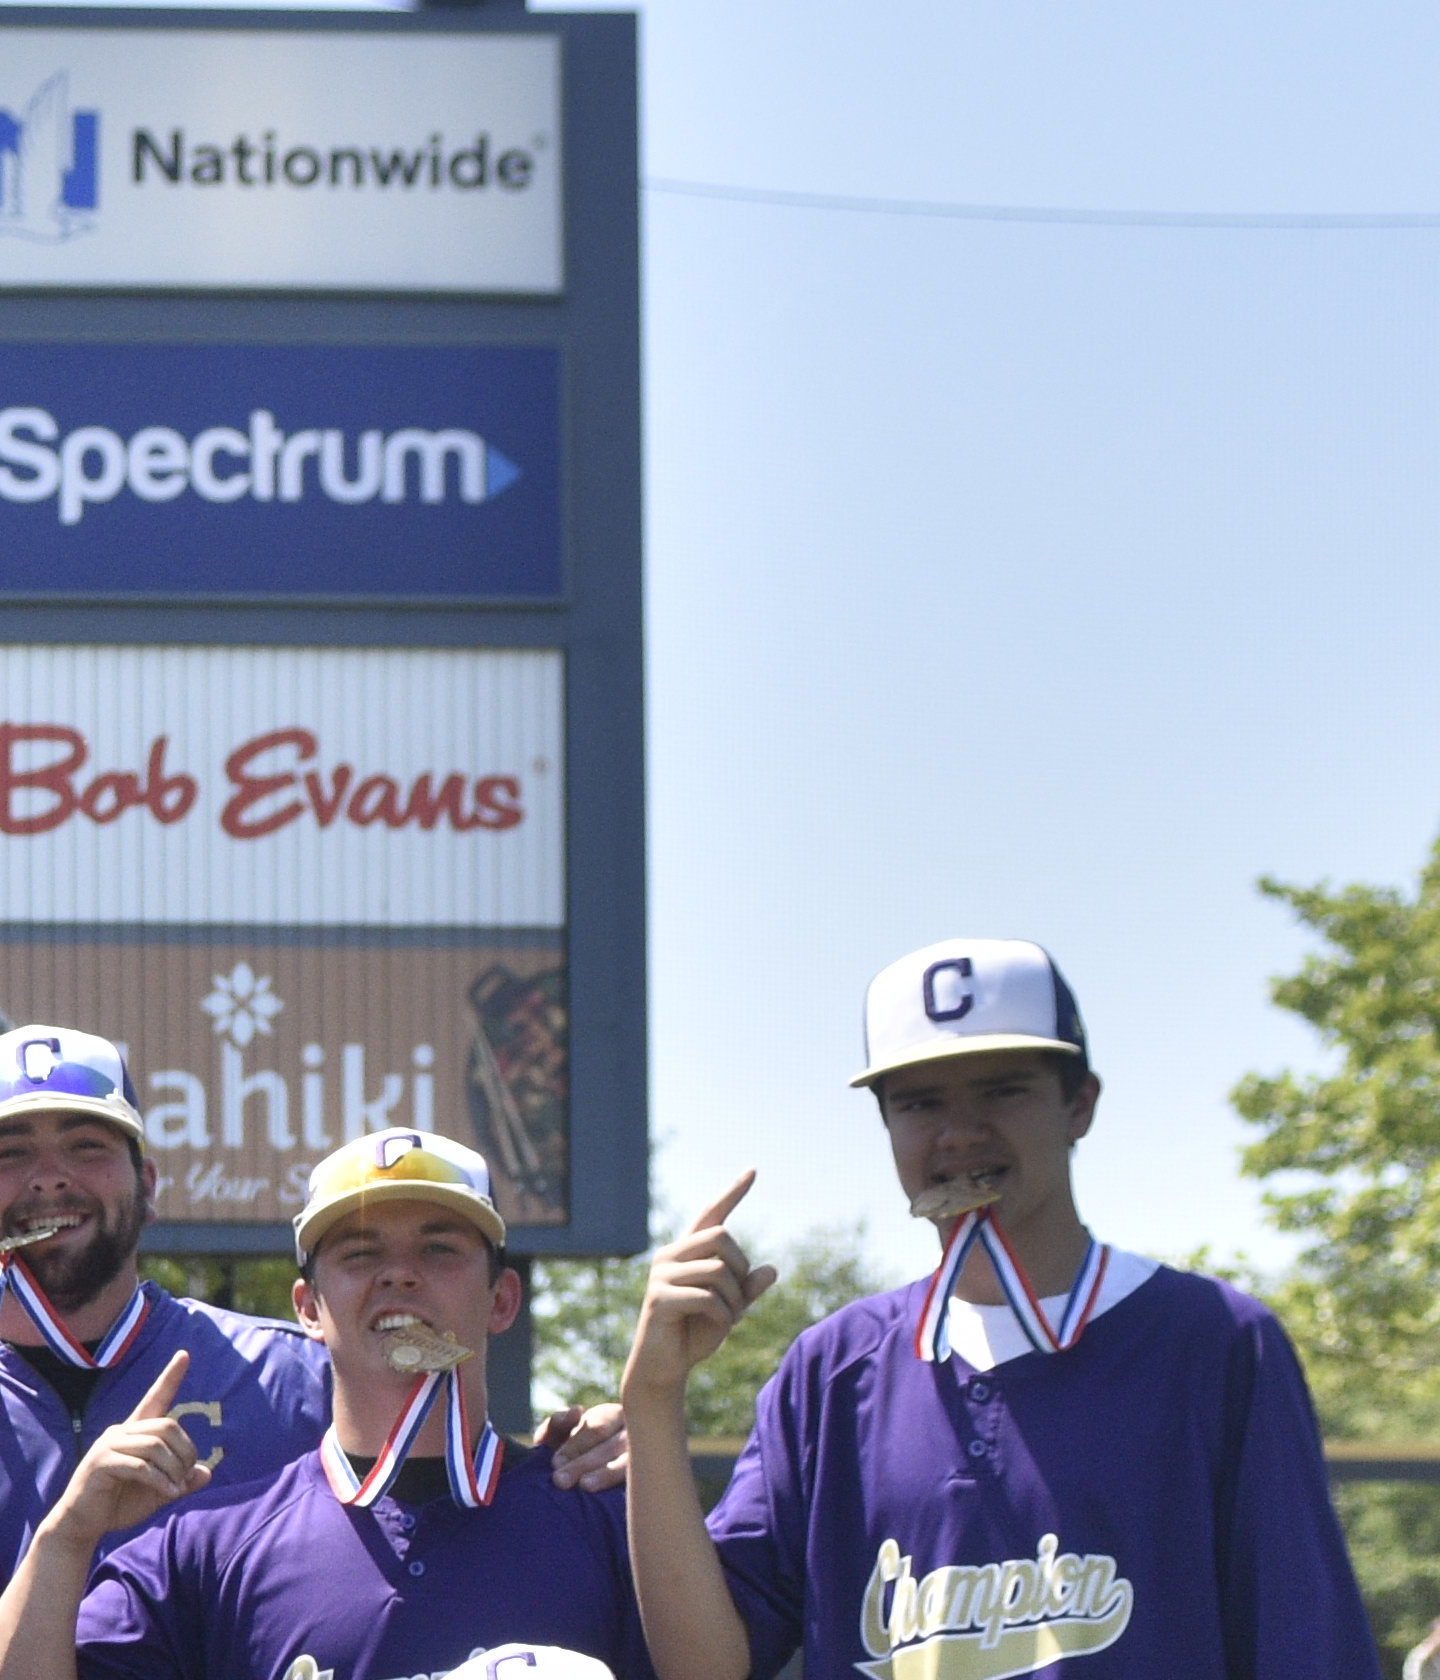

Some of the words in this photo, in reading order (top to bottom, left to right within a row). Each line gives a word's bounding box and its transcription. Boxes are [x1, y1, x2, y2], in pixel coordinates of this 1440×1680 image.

[130, 128, 536, 191] Nationwide
[221, 727, 525, 840] Evans
[923, 957, 977, 1023] C
[123, 1041, 435, 1149] ahiki
[860, 1533, 1134, 1660] Champion
